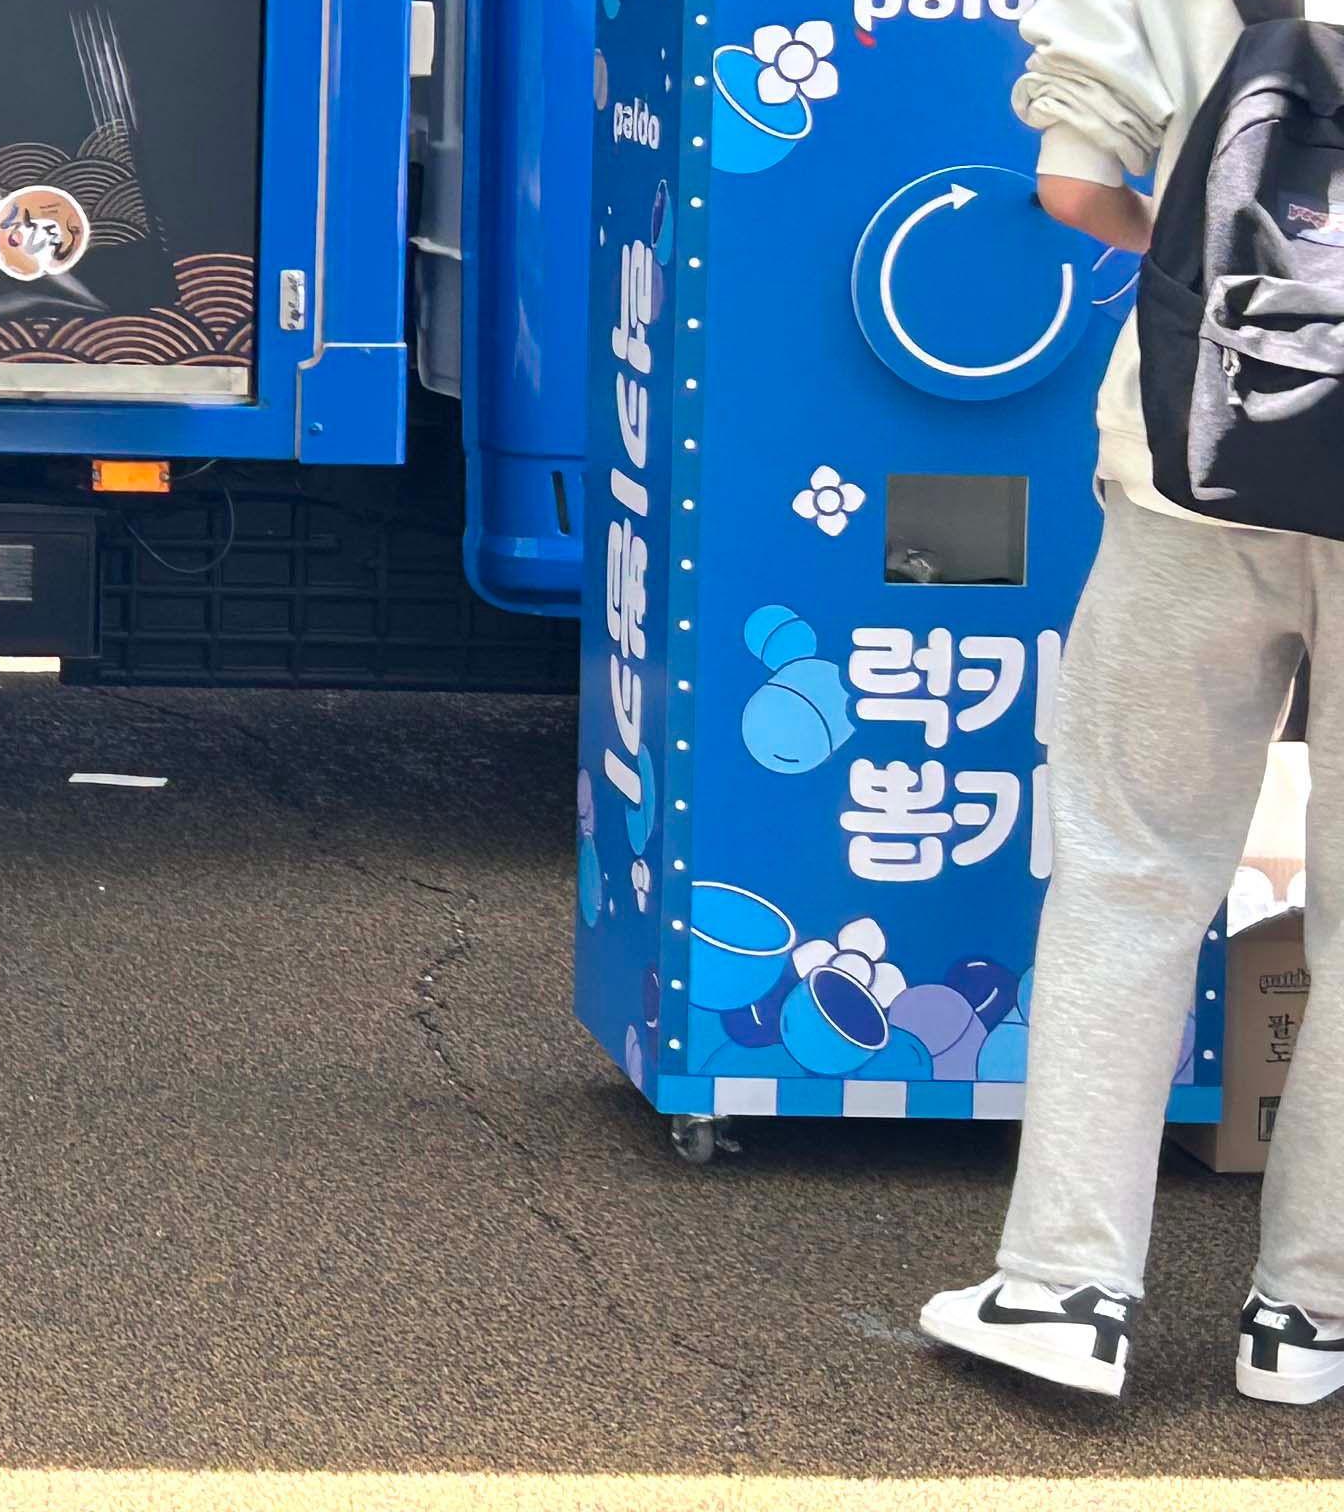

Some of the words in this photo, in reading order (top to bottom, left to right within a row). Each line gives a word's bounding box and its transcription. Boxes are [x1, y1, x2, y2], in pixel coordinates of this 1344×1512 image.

[613, 96, 660, 150] paldo
[849, 627, 1062, 749] 럭키
[840, 758, 1053, 882] 뽑키
